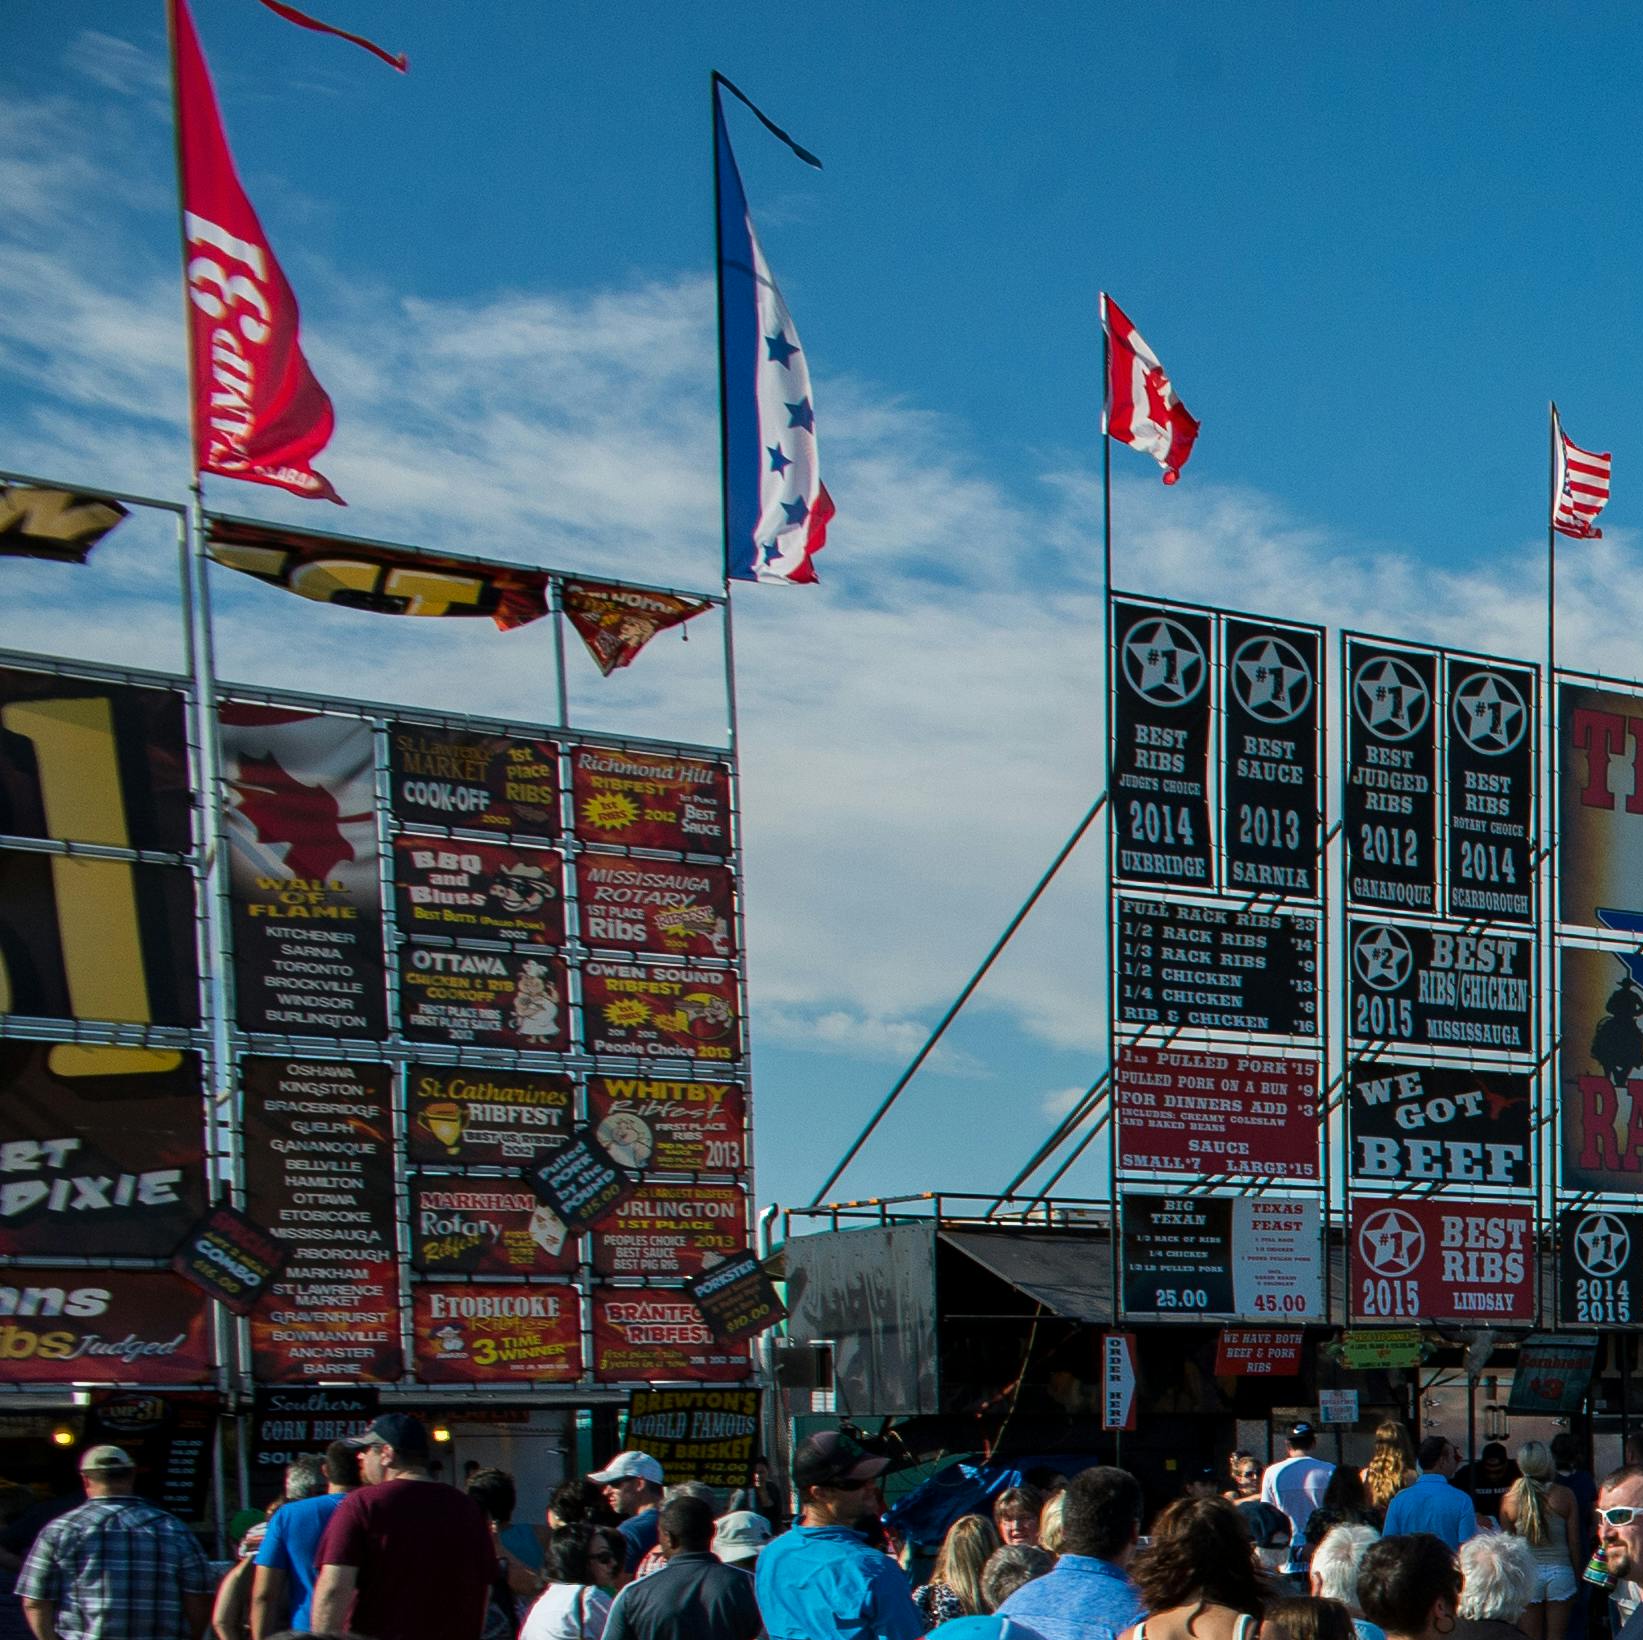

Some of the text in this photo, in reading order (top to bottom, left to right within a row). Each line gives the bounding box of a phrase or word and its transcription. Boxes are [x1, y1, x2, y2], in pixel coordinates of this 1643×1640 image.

[183, 209, 272, 345] 31
[1135, 723, 1188, 750] BEST
[1243, 735, 1295, 761] BEST
[402, 752, 489, 783] MARKET
[578, 753, 716, 785] Richmond Hill
[1135, 749, 1185, 774] RIBS
[1365, 745, 1415, 769] BEST
[1237, 759, 1303, 785] SAUCE
[1353, 767, 1428, 793] JUDGED
[402, 781, 492, 812] COOK-OFF
[505, 782, 552, 805] RIBS
[590, 775, 670, 797] RIBFEST
[1365, 791, 1413, 815] RIBS
[1130, 800, 1194, 846] 2014
[1239, 803, 1300, 851] 2013
[1361, 823, 1418, 867] 2012
[410, 851, 483, 875] BBQ
[1120, 851, 1206, 878] UXBRIDGE
[1233, 861, 1311, 889] SARNIA
[1461, 840, 1516, 884] 2014
[256, 877, 351, 893] WALL
[428, 872, 471, 887] and
[586, 867, 711, 893] MISSISSAUGA
[1353, 877, 1432, 906] GANANOQUE
[279, 891, 326, 905] OF
[408, 885, 487, 907] Blues
[593, 885, 697, 907] ROTARY
[1451, 887, 1529, 915] SCARBOROUGH
[248, 904, 358, 919] FLAME
[1121, 900, 1282, 930] FULL RACK RIBS
[264, 926, 356, 944] KITCHENER
[588, 917, 648, 943] Ribs
[411, 950, 509, 977] OTTAWA
[1430, 934, 1518, 975] BEST
[585, 962, 725, 985] OWEN SOUND
[604, 979, 683, 996] RIBFEST
[1418, 969, 1528, 1012] RIBS/CHICKEN
[275, 993, 355, 1010] WINDSOR
[264, 1009, 367, 1028] BURLINGTON
[1357, 993, 1413, 1039] 2015
[1426, 1019, 1522, 1046] MISSISSAUGA
[594, 1040, 732, 1059] People Choice 2013
[603, 1078, 733, 1103] WHITBY
[1357, 1071, 1424, 1106] WE
[466, 1102, 564, 1128] RIBFEST
[1120, 1090, 1289, 1116] FOR DINNERS ADD
[1396, 1091, 1485, 1130] GOT
[704, 1140, 740, 1169] 2013
[1187, 1139, 1250, 1155] SAUCE
[1357, 1135, 1524, 1183] BEEF
[0, 1169, 183, 1216] DIXIE
[419, 1191, 537, 1212] MARKHAM
[1251, 1203, 1304, 1215] TEXAS
[420, 1211, 503, 1245] Rotary
[1251, 1220, 1304, 1232] FEAST
[1440, 1216, 1527, 1251] BEST
[1442, 1250, 1526, 1285] RIBS
[1155, 1289, 1208, 1308] 25.00
[1363, 1278, 1421, 1317] 2015
[1453, 1292, 1515, 1312] LINDSAY
[1576, 1279, 1630, 1301] 2014
[429, 1293, 560, 1319] ETOBICOKE
[1254, 1294, 1306, 1313] 45.00
[1577, 1301, 1631, 1324] 2015
[59, 1333, 187, 1364] Judged
[632, 1391, 758, 1417] BREWTON'S
[631, 1409, 757, 1439] WORLD FAMOUS
